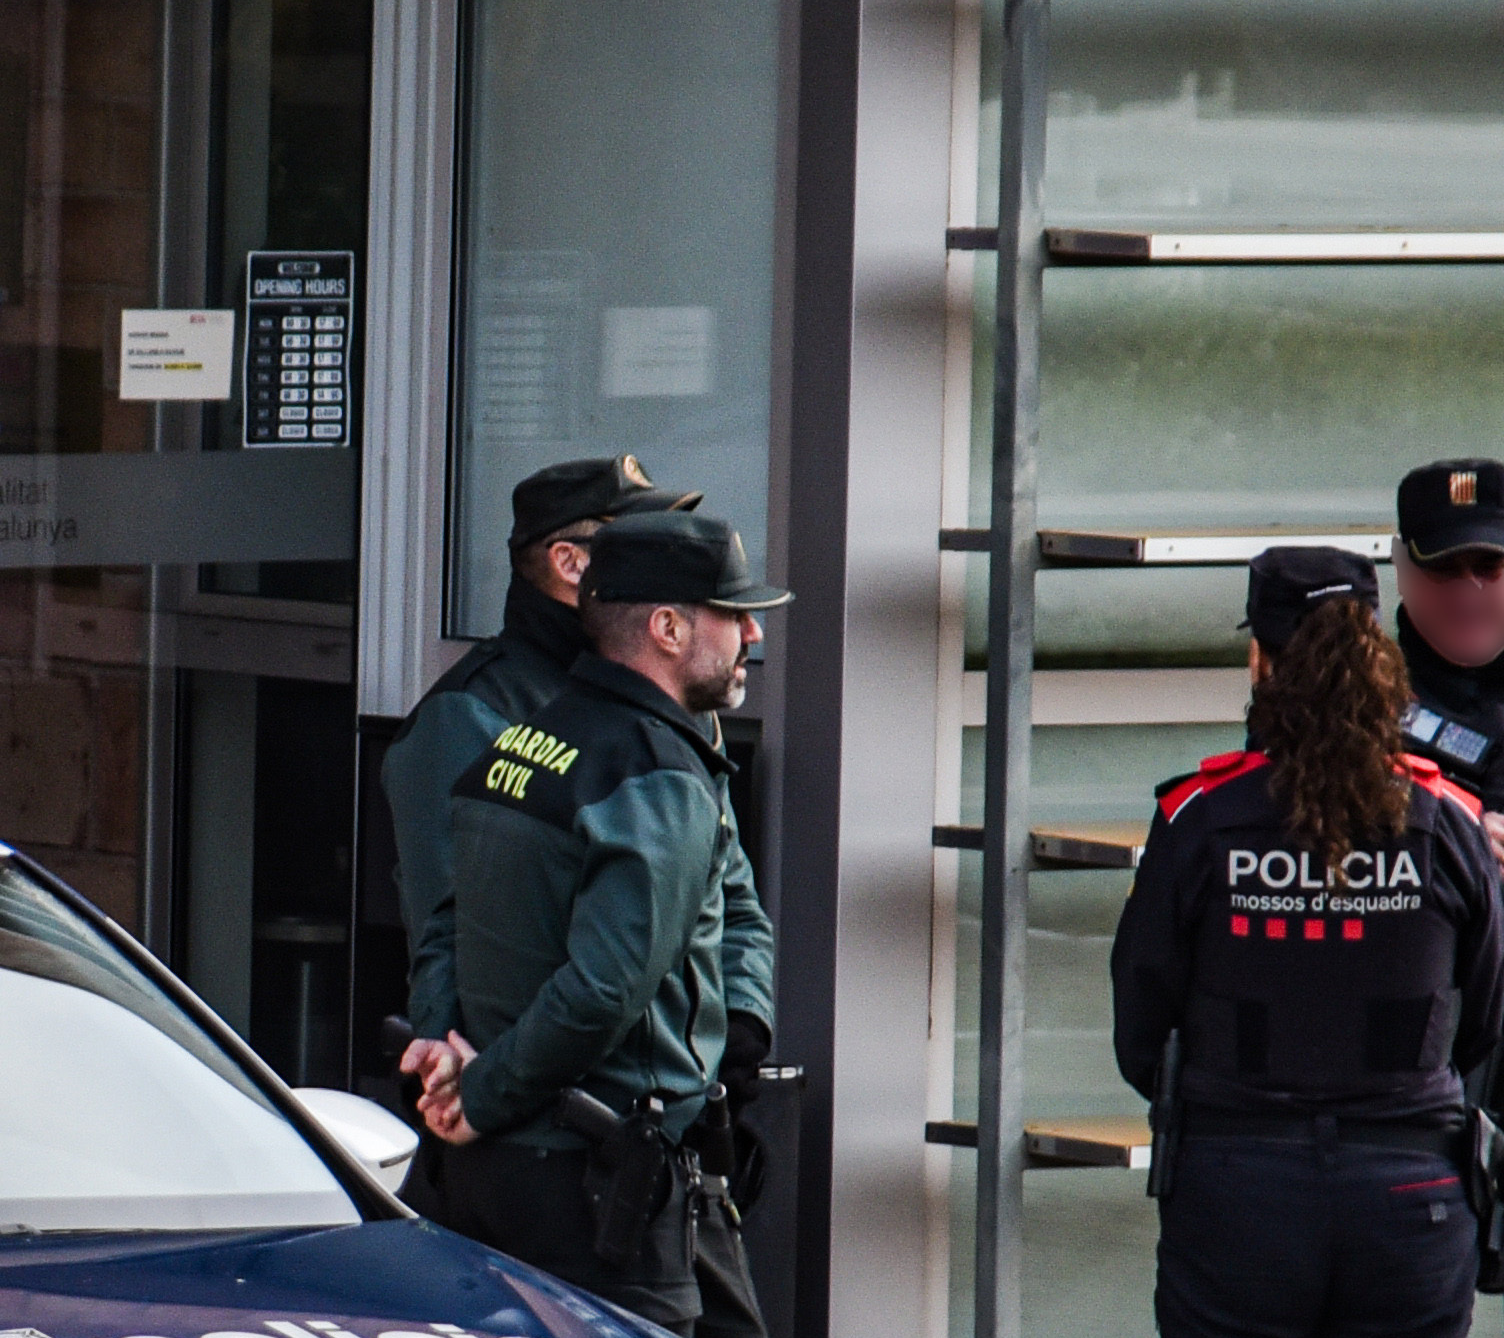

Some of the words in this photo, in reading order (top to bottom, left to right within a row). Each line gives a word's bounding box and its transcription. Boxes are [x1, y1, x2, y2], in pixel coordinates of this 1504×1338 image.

[254, 278, 303, 295] OPENING
[305, 278, 346, 295] HOURS
[486, 758, 534, 799] CIVIL
[1231, 893, 1306, 911] mossos
